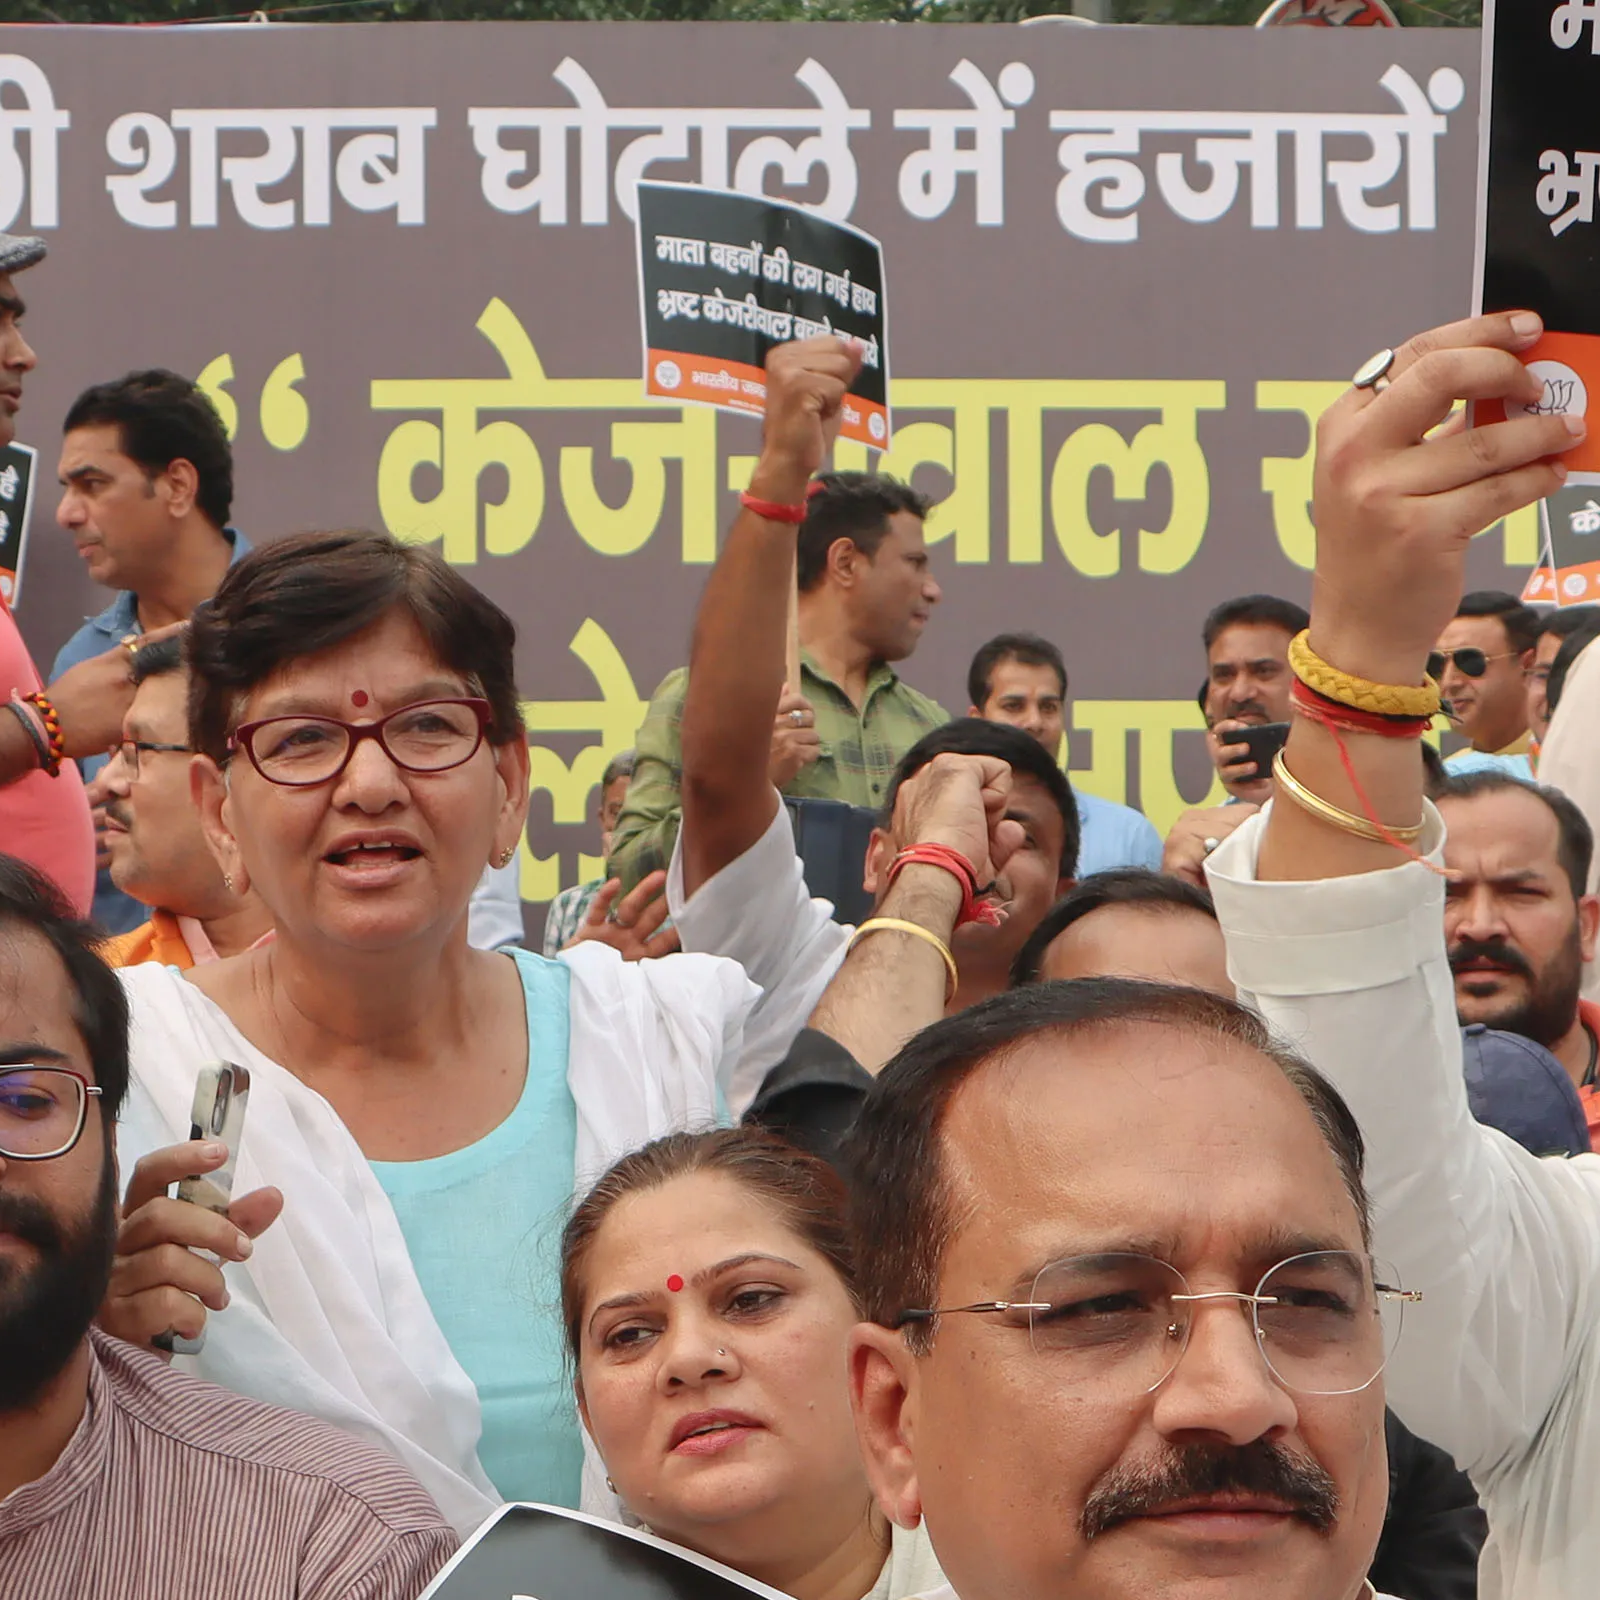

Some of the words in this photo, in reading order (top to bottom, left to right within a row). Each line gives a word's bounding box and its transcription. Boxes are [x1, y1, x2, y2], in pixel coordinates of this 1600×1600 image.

[104, 106, 437, 229] शराब
[468, 56, 870, 226] घोटाले
[893, 57, 1034, 228] में
[1049, 64, 1465, 242] हजारों
[654, 235, 707, 266] माता
[709, 240, 763, 276] बहनों
[762, 246, 791, 284] की
[792, 260, 824, 294] लग
[825, 270, 851, 308] गई
[657, 288, 701, 321] भ्रष्ट
[702, 287, 792, 339] केजरीवाल
[371, 297, 1226, 577] केजवाल
